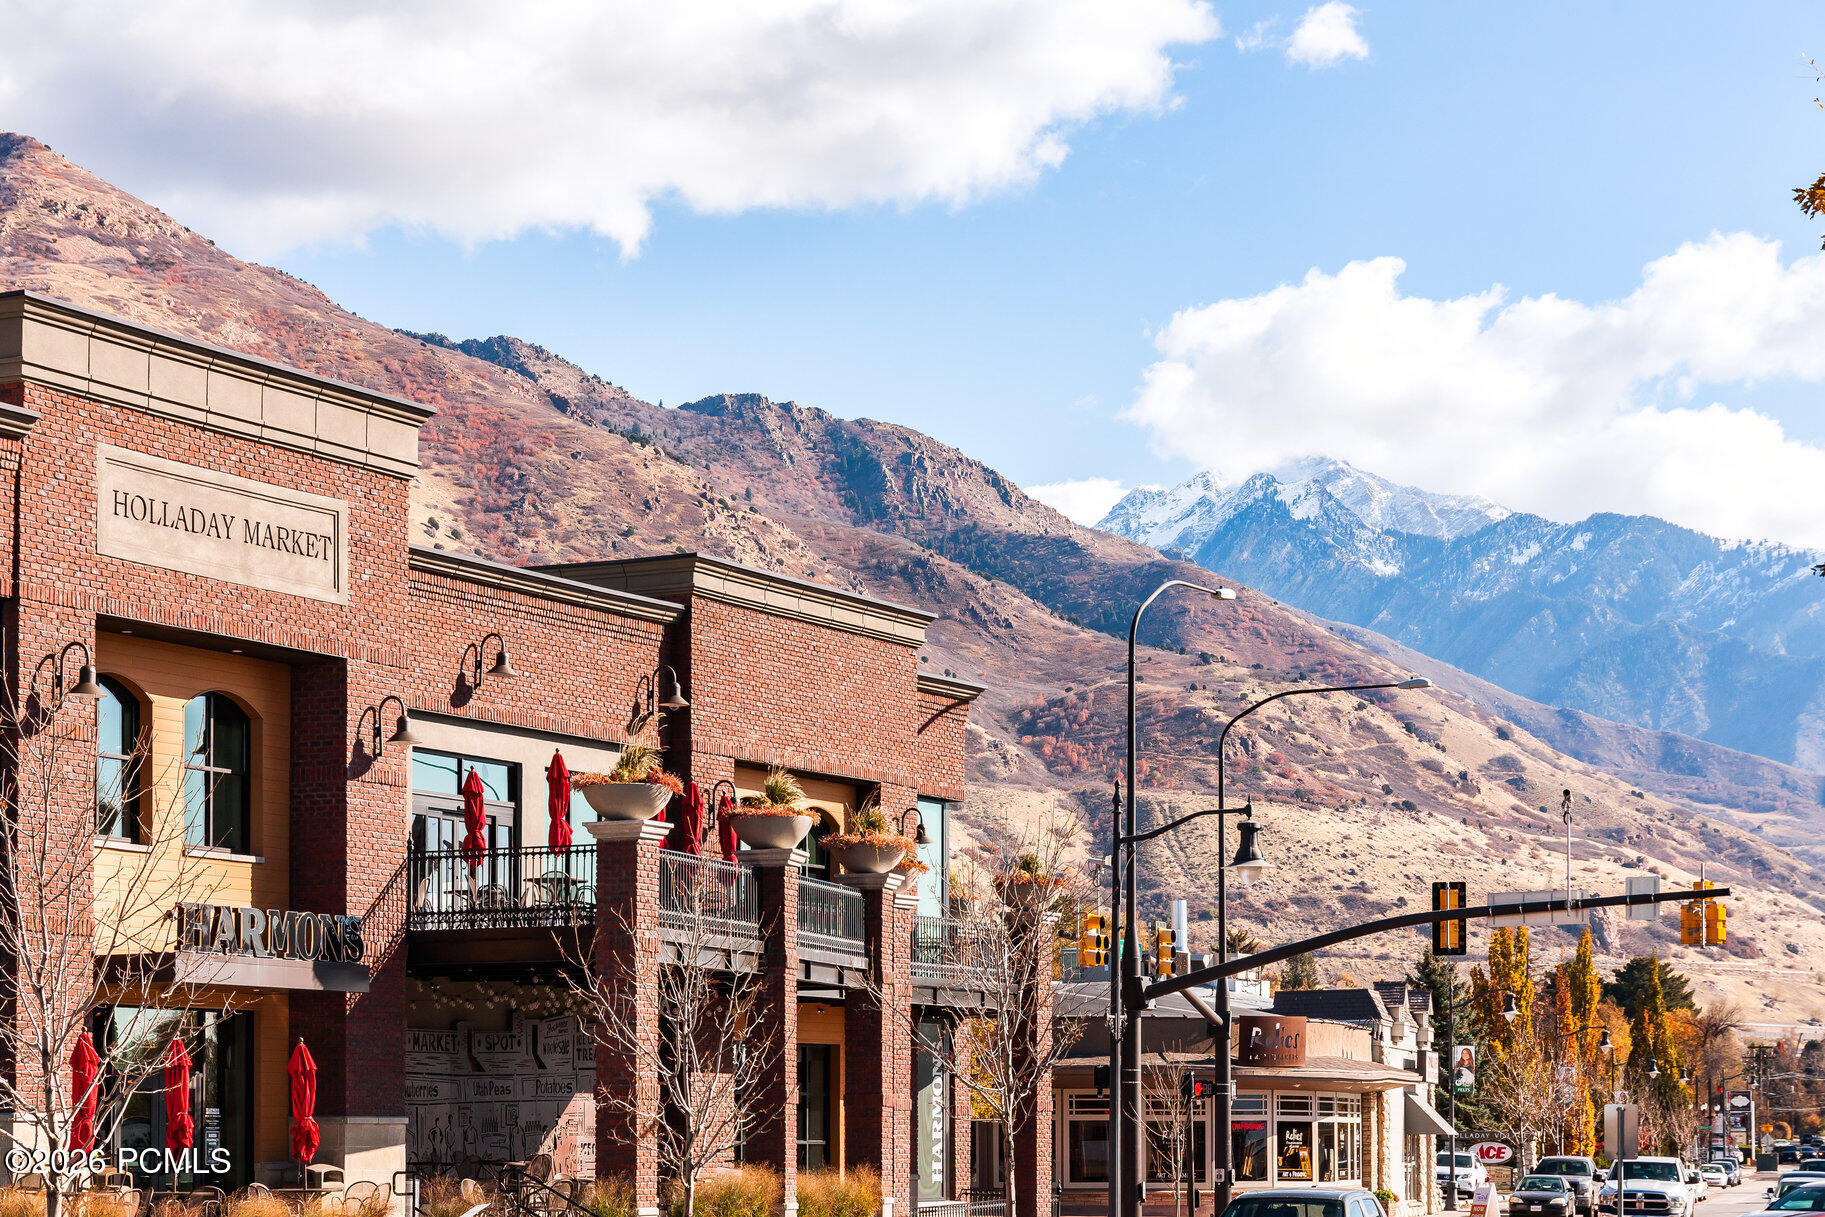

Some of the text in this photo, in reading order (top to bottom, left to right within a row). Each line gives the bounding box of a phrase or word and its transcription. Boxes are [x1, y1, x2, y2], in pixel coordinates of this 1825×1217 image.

[113, 489, 333, 562] HOLLADAY MARKET
[175, 902, 365, 963] HARMONS
[412, 1032, 457, 1052] MARKET
[485, 1033, 516, 1051] SPOT
[1249, 1022, 1300, 1050] Relics
[489, 1080, 512, 1096] Peas
[535, 1078, 573, 1096] Potatoes
[931, 1040, 944, 1184] HARMONS
[1476, 1144, 1507, 1160] ACE
